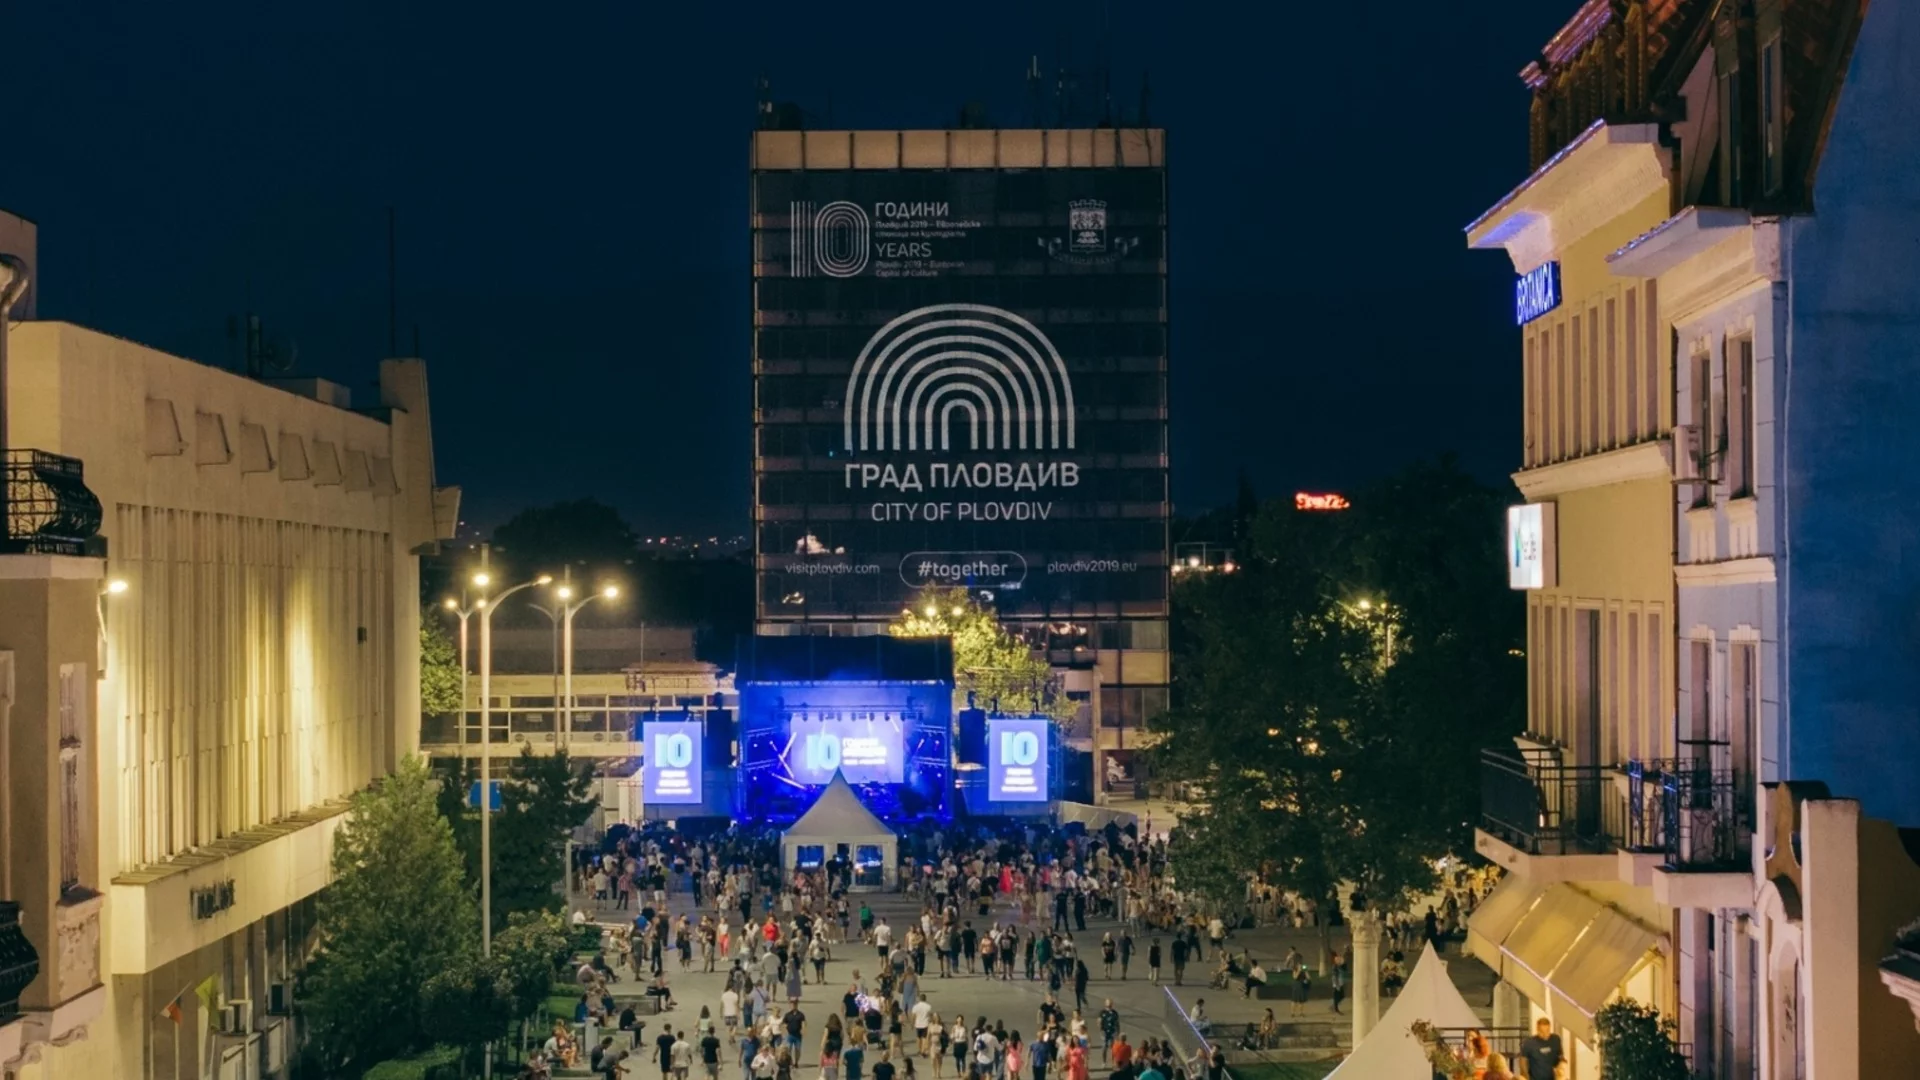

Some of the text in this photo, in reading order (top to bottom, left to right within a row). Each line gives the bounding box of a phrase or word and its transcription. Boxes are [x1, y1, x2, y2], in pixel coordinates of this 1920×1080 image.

[875, 202, 949, 219] ГОДИНИ
[910, 220, 928, 229] 2019
[790, 200, 870, 278] 10
[875, 242, 932, 258] YEARS
[844, 462, 1080, 492] ГРАД ПЛОВДИВ
[871, 501, 1052, 522] CITY OF PLOVDIV
[785, 562, 880, 577] visitplovdiv.com
[918, 560, 1008, 581] #together
[1047, 559, 1137, 574] plovdiv2019.eu
[655, 733, 692, 768] 10
[1001, 731, 1038, 765] 10
